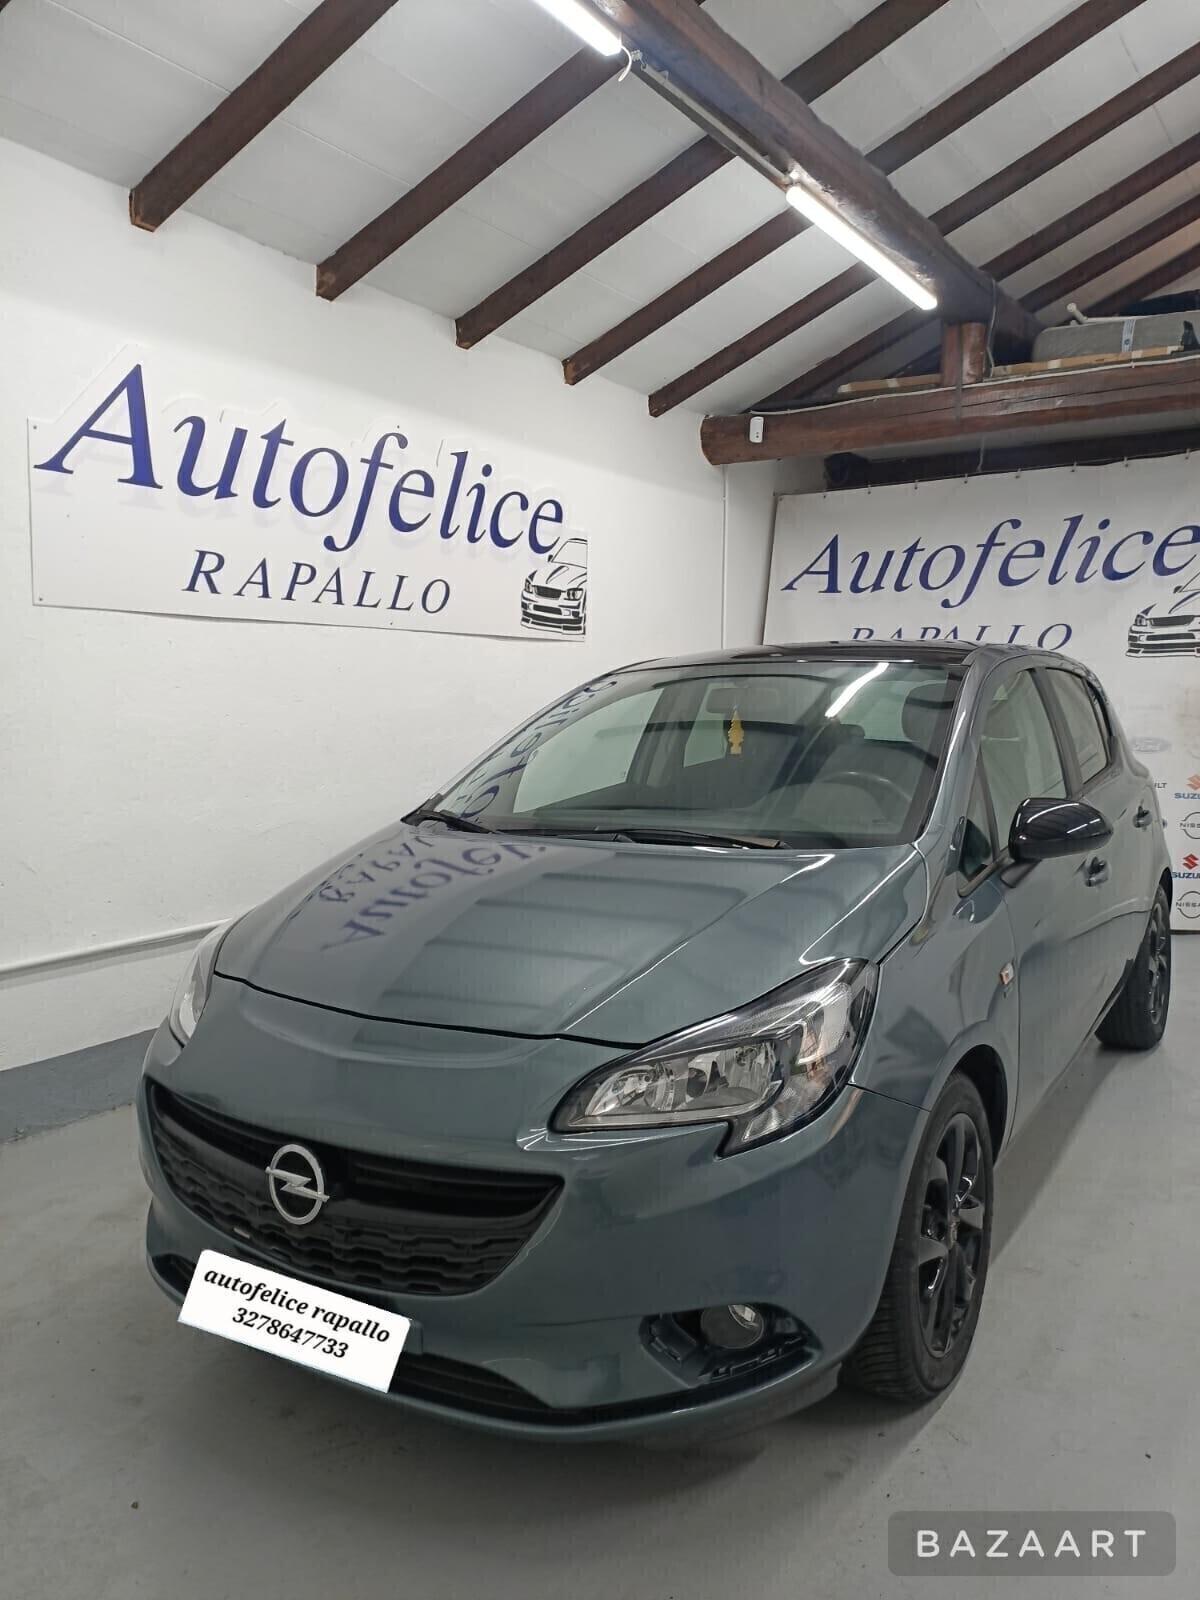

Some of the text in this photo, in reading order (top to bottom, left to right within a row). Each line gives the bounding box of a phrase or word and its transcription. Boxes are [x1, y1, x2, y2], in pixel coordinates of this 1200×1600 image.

[34, 364, 564, 554] Autofelice
[181, 550, 451, 615] RAPALLO
[780, 513, 1200, 609] Autofelice
